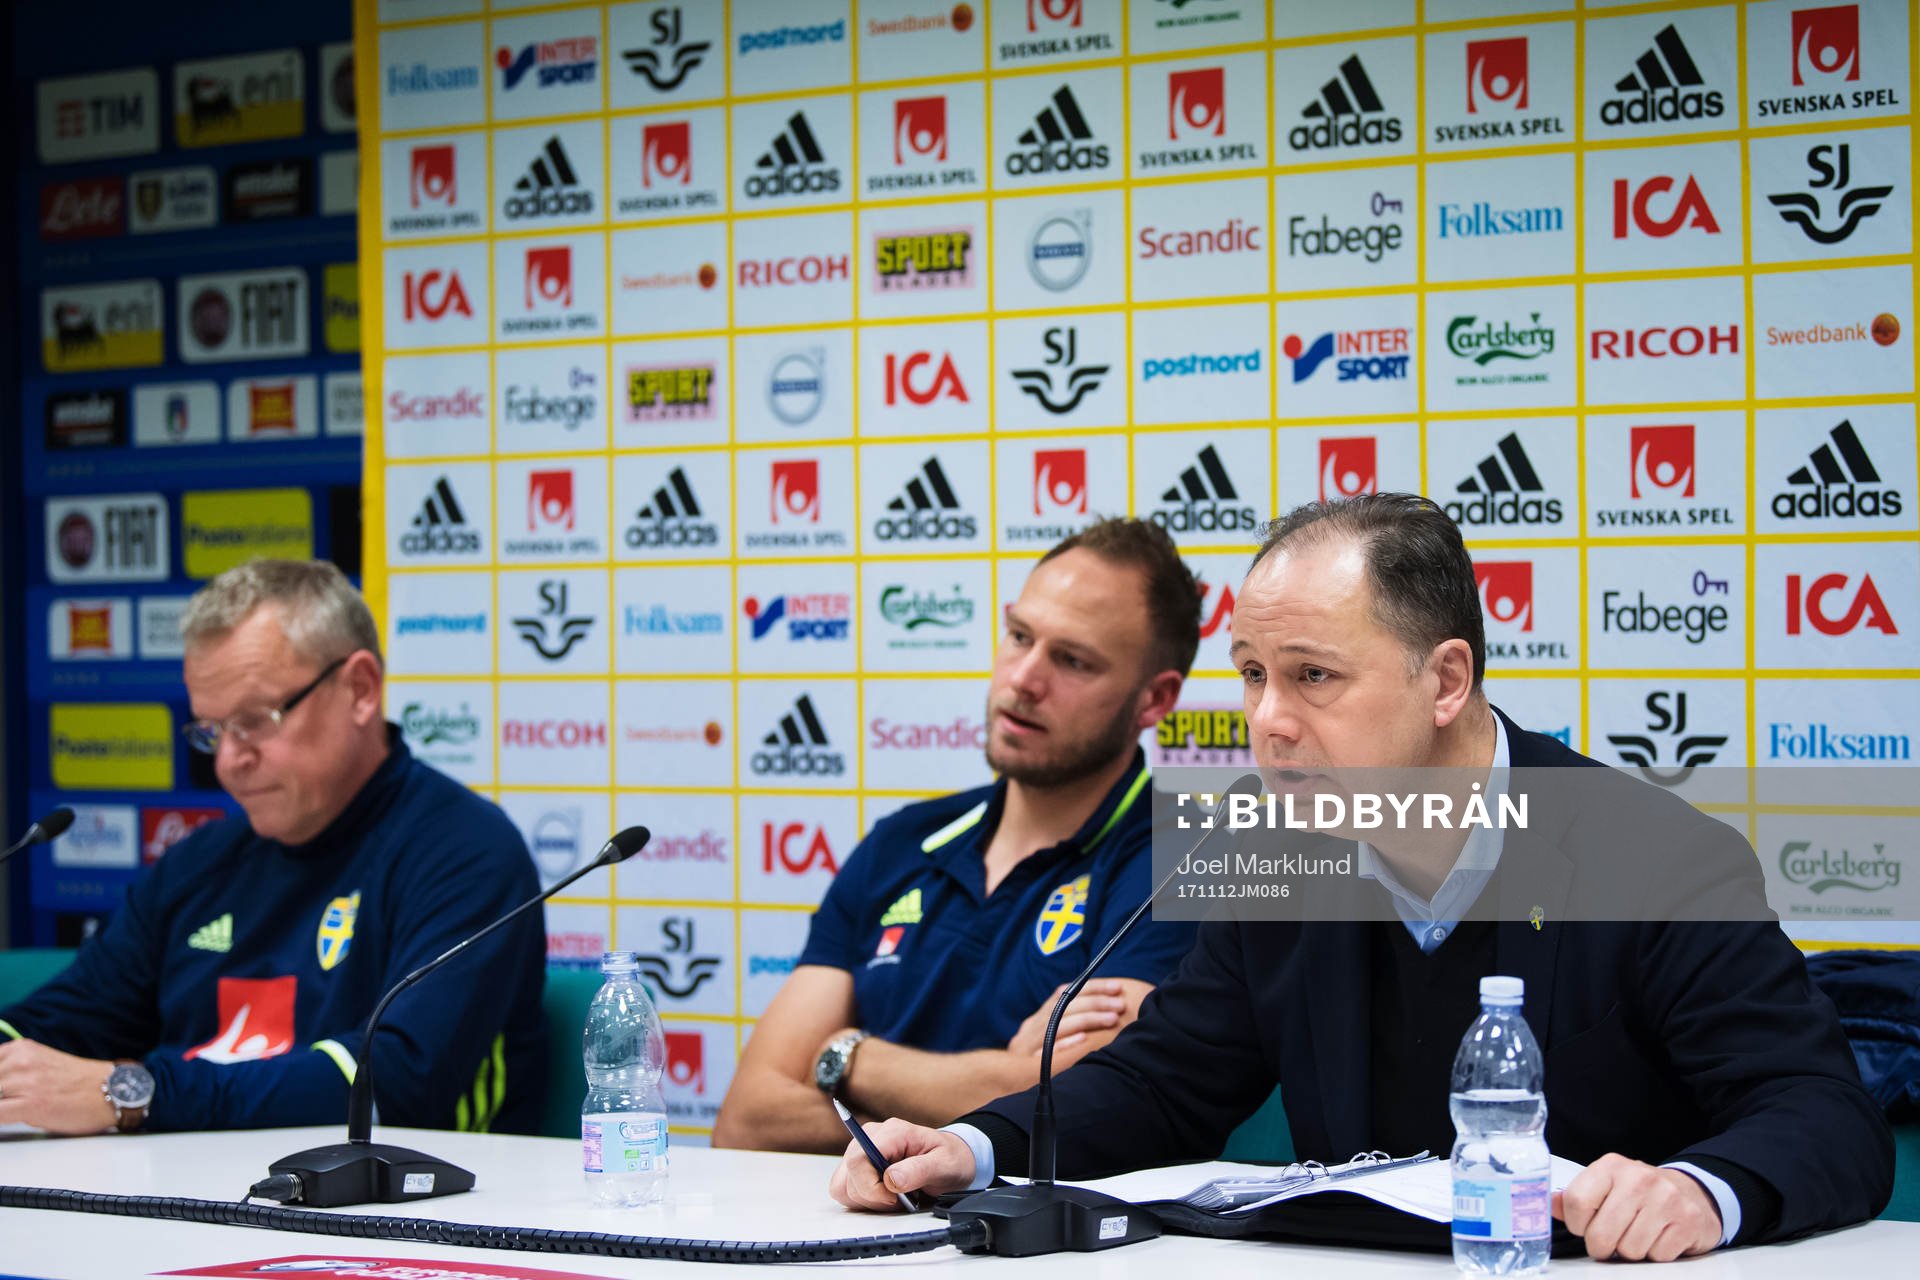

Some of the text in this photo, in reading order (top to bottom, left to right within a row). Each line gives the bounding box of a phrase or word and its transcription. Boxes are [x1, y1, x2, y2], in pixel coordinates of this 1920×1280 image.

[651, 8, 681, 45] SJ
[738, 19, 844, 56] postnord
[868, 14, 947, 36] Swedbank
[538, 37, 596, 61] INTER
[1000, 34, 1112, 60] SVENSKA SPEL
[388, 64, 478, 95] Folksam
[537, 62, 596, 86] SPORT
[1600, 88, 1724, 127] adidas
[1758, 89, 1899, 117] SVENSKA SPEL
[1289, 113, 1402, 151] adidas
[1435, 117, 1564, 143] SVENSKA SPEL
[1006, 142, 1110, 175] adidas
[1140, 144, 1257, 169] SVENSKA SPEL
[1807, 143, 1850, 191] SJ
[744, 166, 841, 198] adidas
[867, 169, 977, 192] SVENSKA SPEL
[504, 189, 594, 220] adidas
[1439, 202, 1563, 239] Folksam
[1613, 172, 1722, 239] ICA
[877, 231, 971, 275] SPORT
[1139, 220, 1261, 259] Scandic
[1289, 214, 1403, 263] Fabege
[738, 255, 849, 287] RICOH
[404, 268, 473, 322] ICA
[1044, 327, 1076, 367] SJ
[1337, 328, 1408, 353] INTER
[1446, 313, 1554, 366] Carlsberg
[1591, 325, 1738, 359] RICOH
[1767, 323, 1866, 346] Swedbank
[885, 351, 970, 406] ICA
[1143, 350, 1260, 381] postnord
[1337, 356, 1409, 381] SPORT
[389, 388, 483, 422] Scandic
[505, 386, 596, 430] Fabege
[1150, 500, 1255, 532] adidas
[1445, 492, 1563, 525] adidas
[1771, 483, 1902, 519] adidas
[625, 520, 717, 549] adidas
[874, 508, 977, 542] adidas
[1597, 508, 1733, 528] SVENSKA SPEL
[400, 528, 481, 556] adidas
[539, 580, 568, 616] SJ
[786, 595, 849, 617] INTER
[1786, 572, 1898, 636] ICA
[788, 620, 849, 641] SPORT
[1604, 591, 1728, 643] Fabege
[1526, 643, 1569, 659] SPEL
[1645, 691, 1687, 735] SJ
[503, 721, 606, 748] RICOH
[870, 718, 986, 750] Scandic
[1156, 710, 1249, 750] SPORT
[1769, 723, 1910, 760] Folksam
[751, 748, 845, 776] adidas
[640, 830, 726, 863] candic
[762, 822, 839, 875] ICA
[1779, 841, 1901, 894] Carlsberg
[662, 917, 692, 952] SJ
